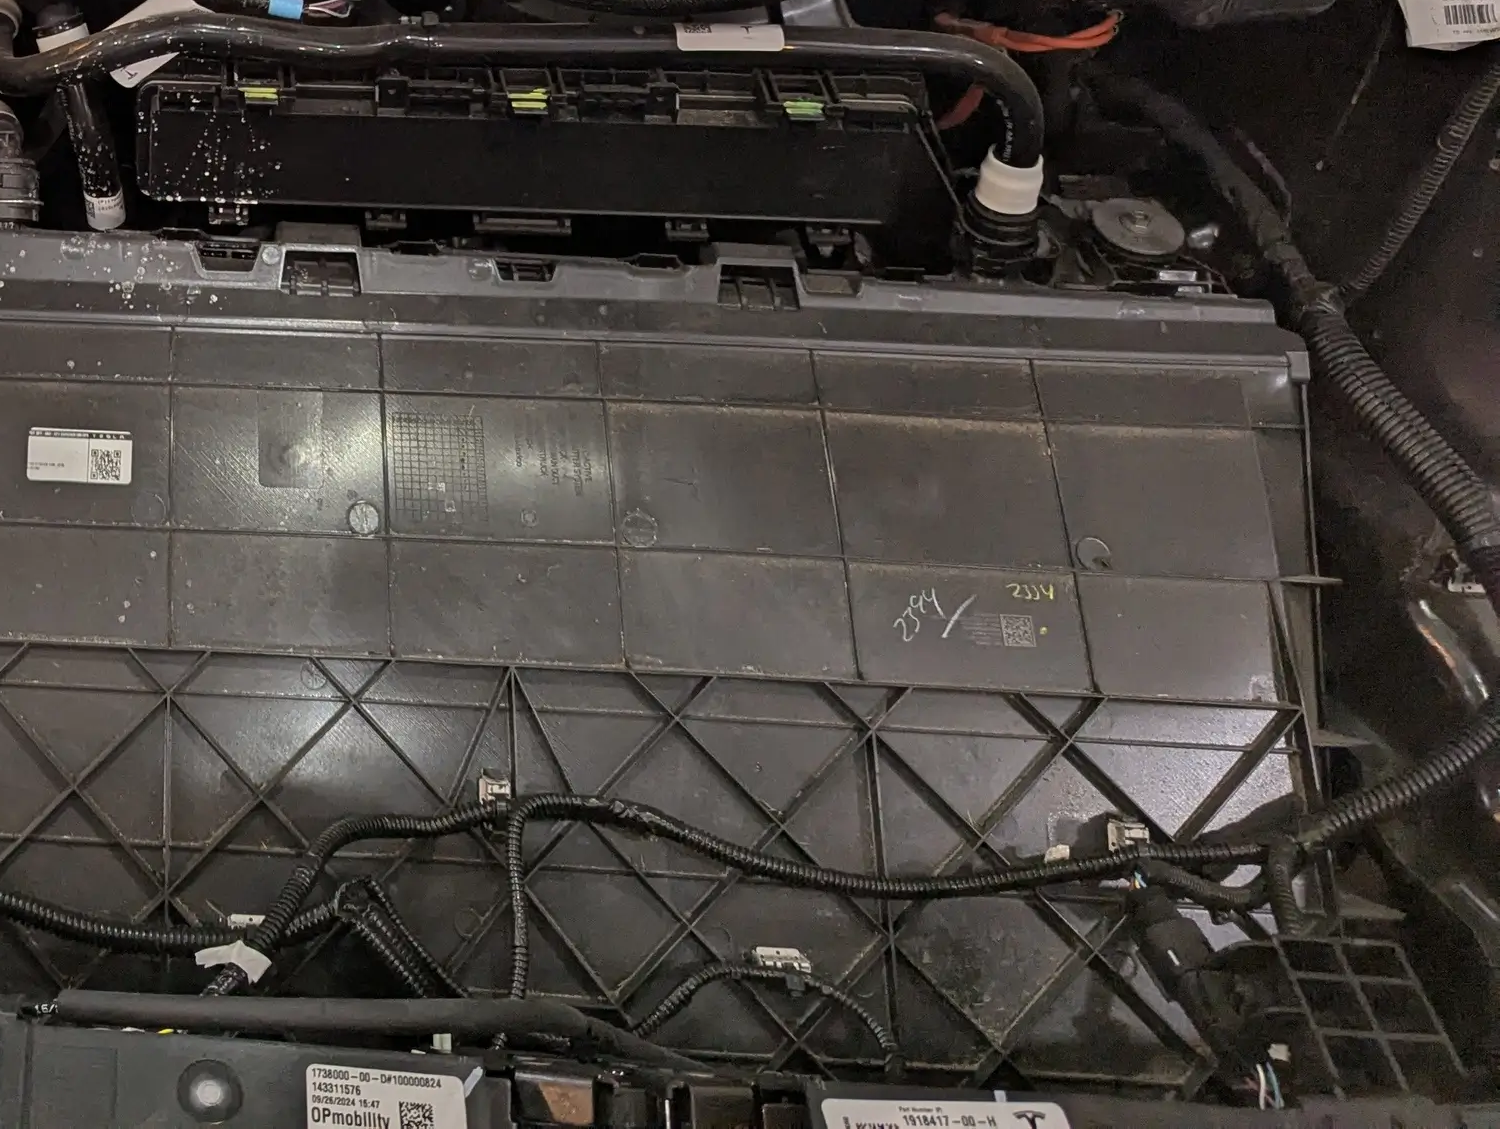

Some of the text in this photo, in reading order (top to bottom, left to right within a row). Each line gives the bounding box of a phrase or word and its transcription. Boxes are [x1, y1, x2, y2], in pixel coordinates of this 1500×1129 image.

[312, 1082, 361, 1095] 143311576
[312, 1094, 380, 1109] 09/26/2024 15:47
[902, 1114, 997, 1128] 1918417-00-H
